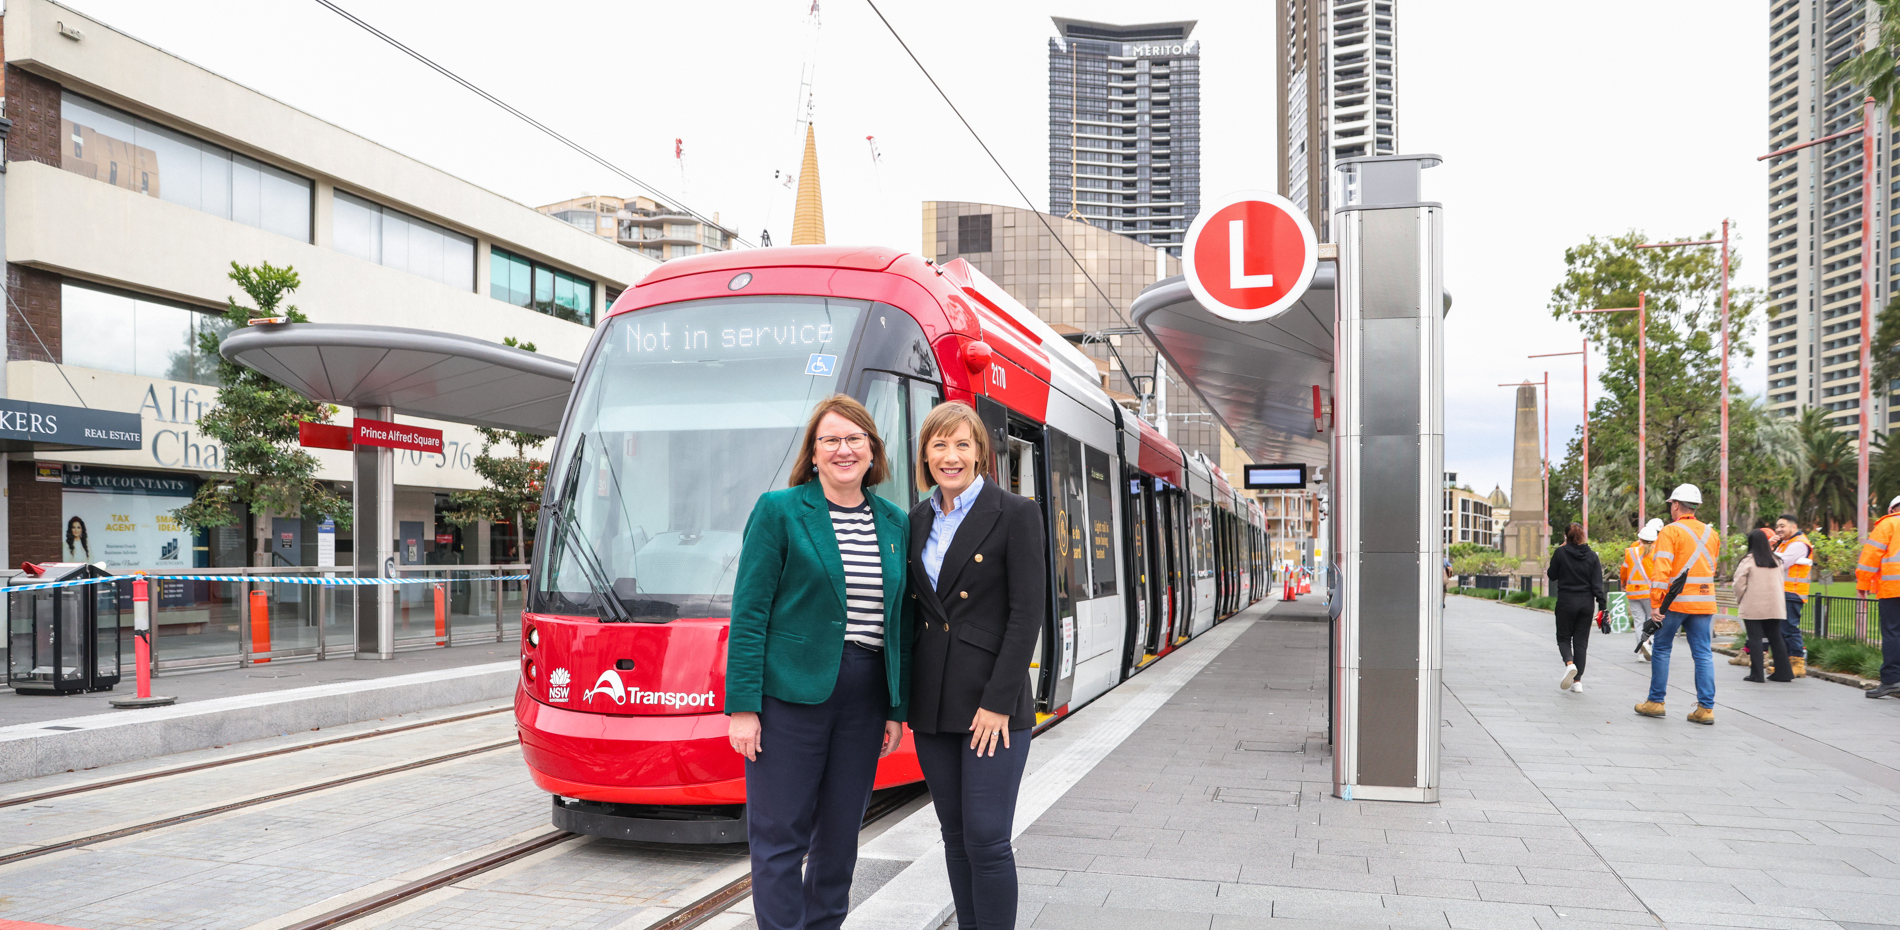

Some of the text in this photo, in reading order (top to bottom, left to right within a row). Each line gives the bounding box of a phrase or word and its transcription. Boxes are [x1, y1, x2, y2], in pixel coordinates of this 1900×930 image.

[1133, 44, 1191, 56] MERITON
[1228, 219, 1274, 290] L
[626, 319, 833, 352] Not in service
[991, 362, 1006, 390] 2170
[140, 383, 225, 425] Alfr
[84, 428, 141, 442] REAL ESTATE
[360, 426, 440, 447] Prince Alfred Square
[94, 476, 184, 490] ACCOUNTANTS
[111, 514, 130, 523] TAX
[155, 515, 183, 524] SMA
[105, 523, 136, 532] AGENT
[158, 523, 182, 532] IDEAS
[549, 687, 570, 699] NSW
[627, 686, 716, 709] Transport
